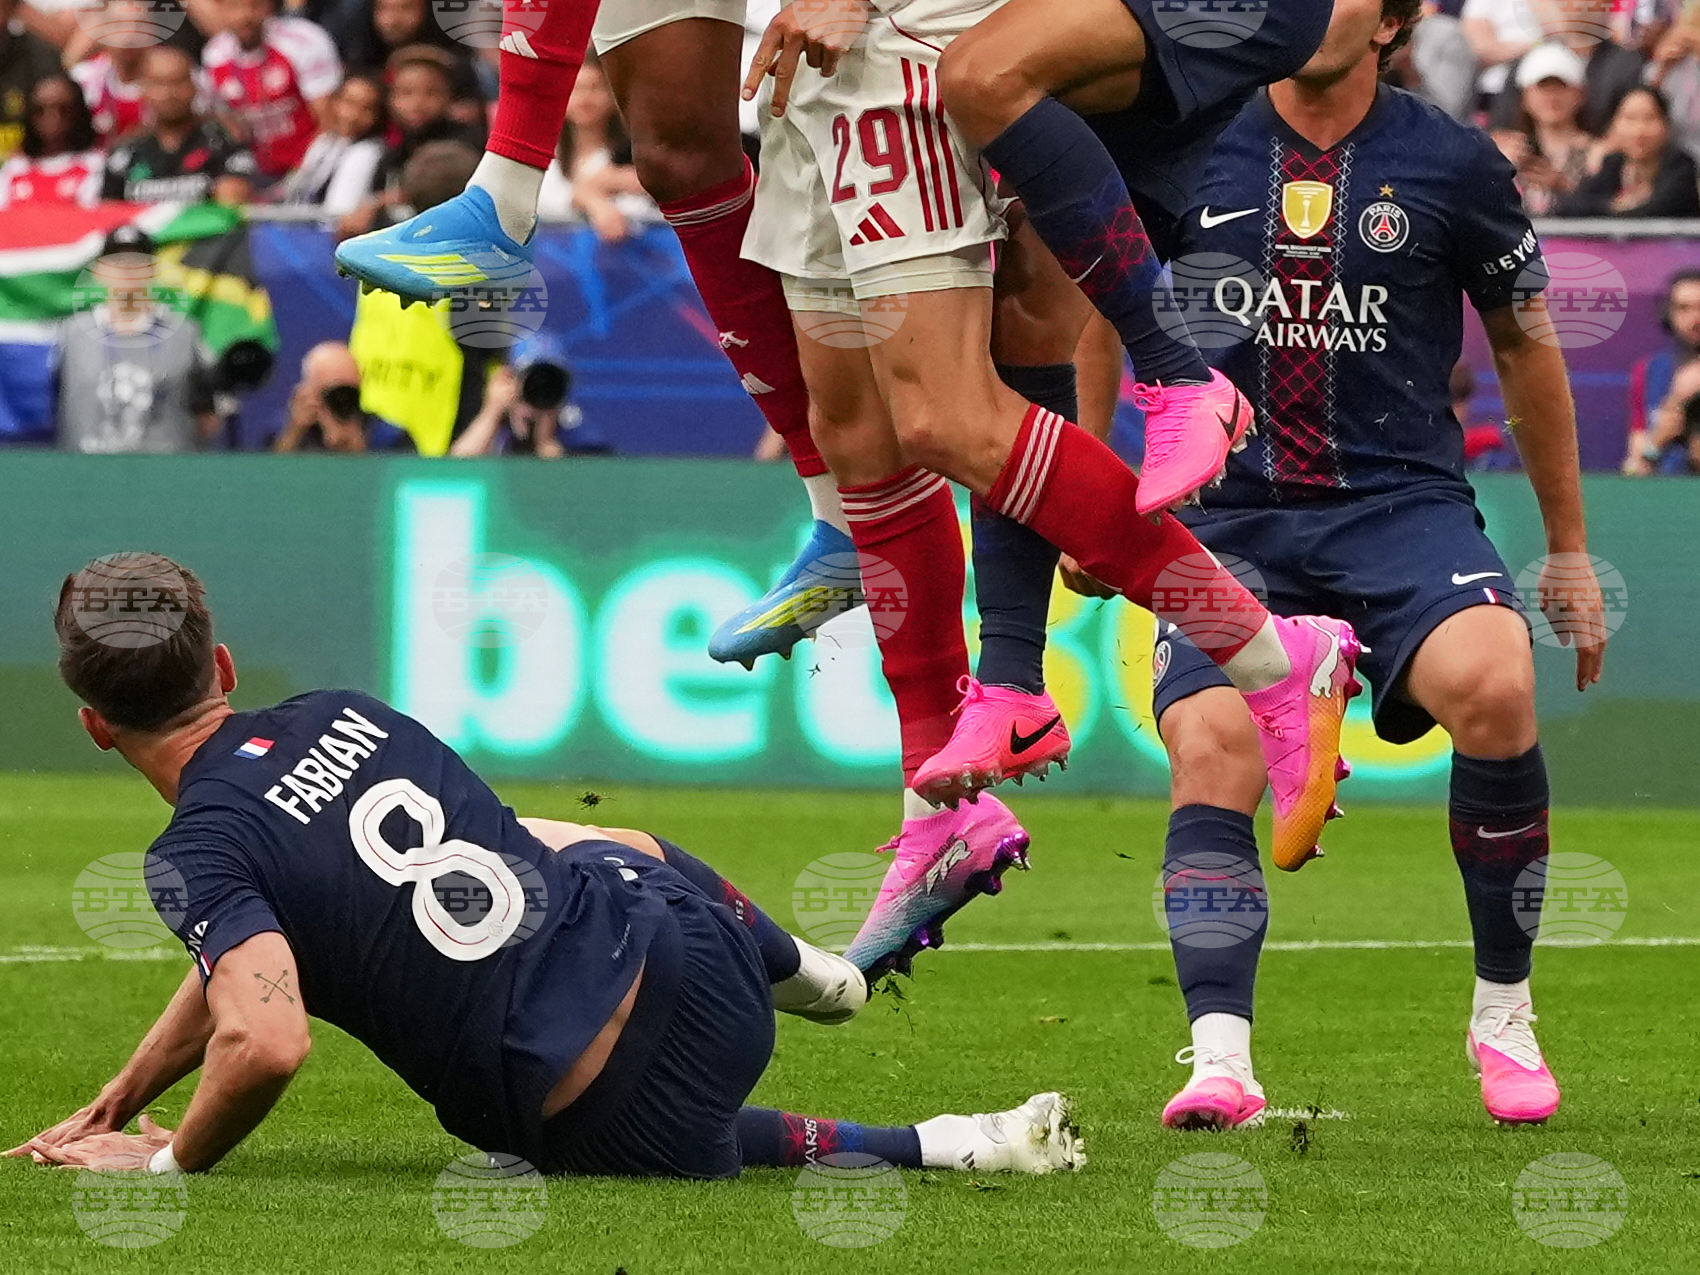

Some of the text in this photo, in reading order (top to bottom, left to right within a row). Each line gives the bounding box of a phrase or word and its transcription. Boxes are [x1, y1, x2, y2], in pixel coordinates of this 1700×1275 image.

[831, 107, 909, 206] 29
[1368, 204, 1402, 219] PARIS
[1214, 276, 1388, 327] QATAR
[1254, 322, 1388, 353] AIRWAYS
[264, 707, 389, 825] FABIAN
[349, 778, 526, 962] 8
